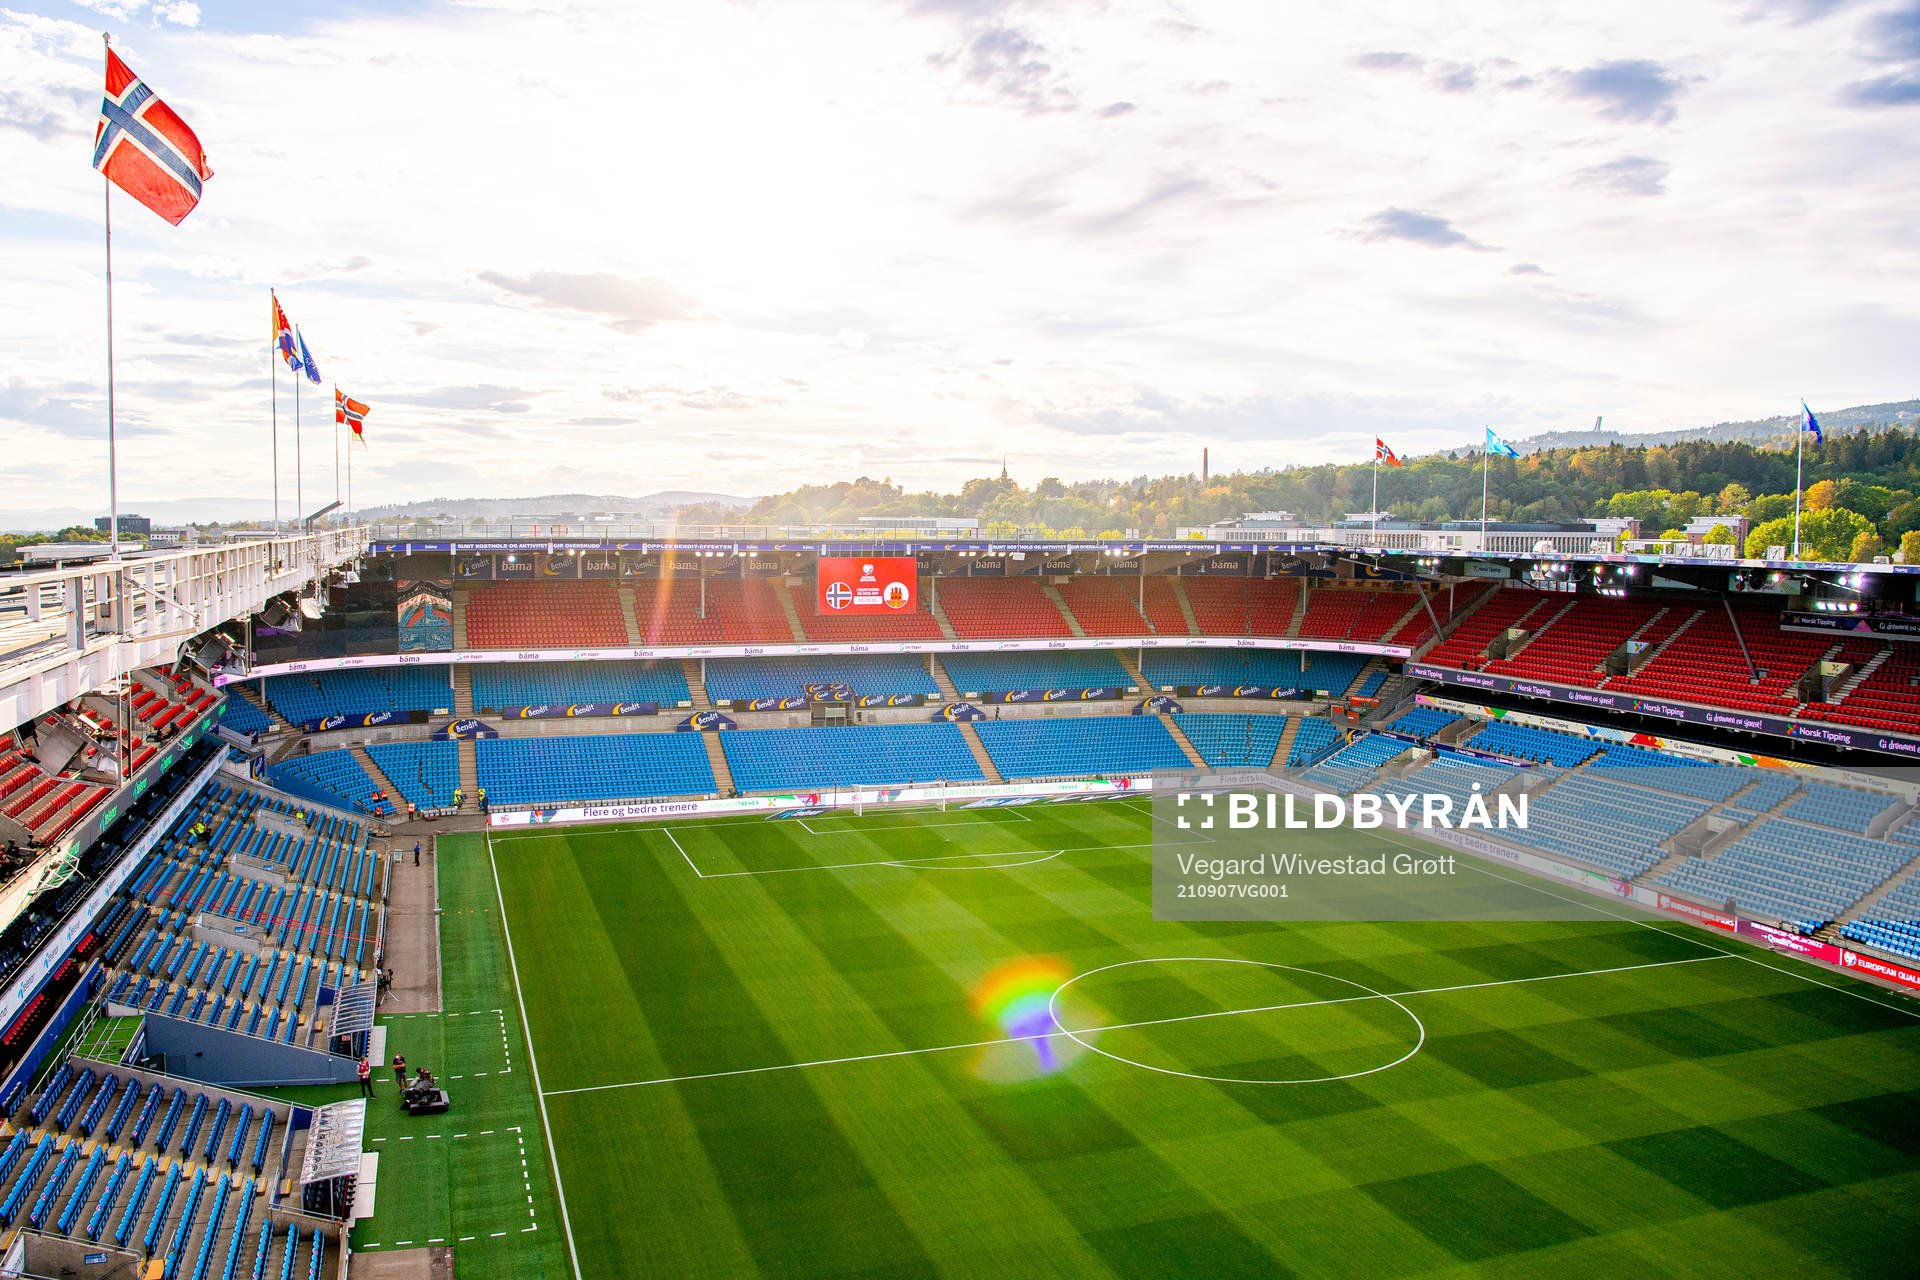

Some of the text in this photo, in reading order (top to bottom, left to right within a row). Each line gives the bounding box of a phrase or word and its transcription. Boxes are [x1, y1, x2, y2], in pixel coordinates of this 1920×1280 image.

[1415, 668, 1443, 680] Norsk Tipping
[1012, 691, 1028, 702] Bendit
[1050, 690, 1066, 701] Bendit
[1087, 688, 1104, 700] Bendit
[1204, 686, 1221, 696] Bendit
[1241, 687, 1258, 697] Bendit
[1278, 687, 1296, 698] Bendit
[1517, 684, 1552, 697] Norsk Tipping
[757, 698, 775, 710] Bendit
[787, 698, 804, 709] Bendit
[866, 695, 884, 706] Bendit
[894, 694, 912, 706] Bendit
[528, 705, 548, 717] Bendit
[574, 704, 594, 716] Bendit
[620, 702, 640, 714] Bendit
[951, 703, 970, 716] Bendit
[1643, 703, 1685, 719] Norsk Tipping
[327, 716, 345, 728] Bendit
[371, 712, 392, 725] Bendit
[698, 712, 719, 725] Bendit
[456, 720, 478, 733] Bendit
[1799, 727, 1852, 745] Norsk Tipping
[1220, 776, 1237, 784] Finn
[1852, 775, 1888, 789] Norsk Tipping
[583, 807, 609, 817] Flere
[613, 808, 625, 817] og
[627, 804, 657, 815] bedre
[660, 802, 698, 812] trenere
[1434, 826, 1520, 861] Flere og bedre trenere
[1670, 901, 1735, 928] EUROPEAN QUALIFIERS
[1767, 934, 1804, 952] Qualifiers
[1858, 958, 1920, 985] EUROPEAN QUALI
